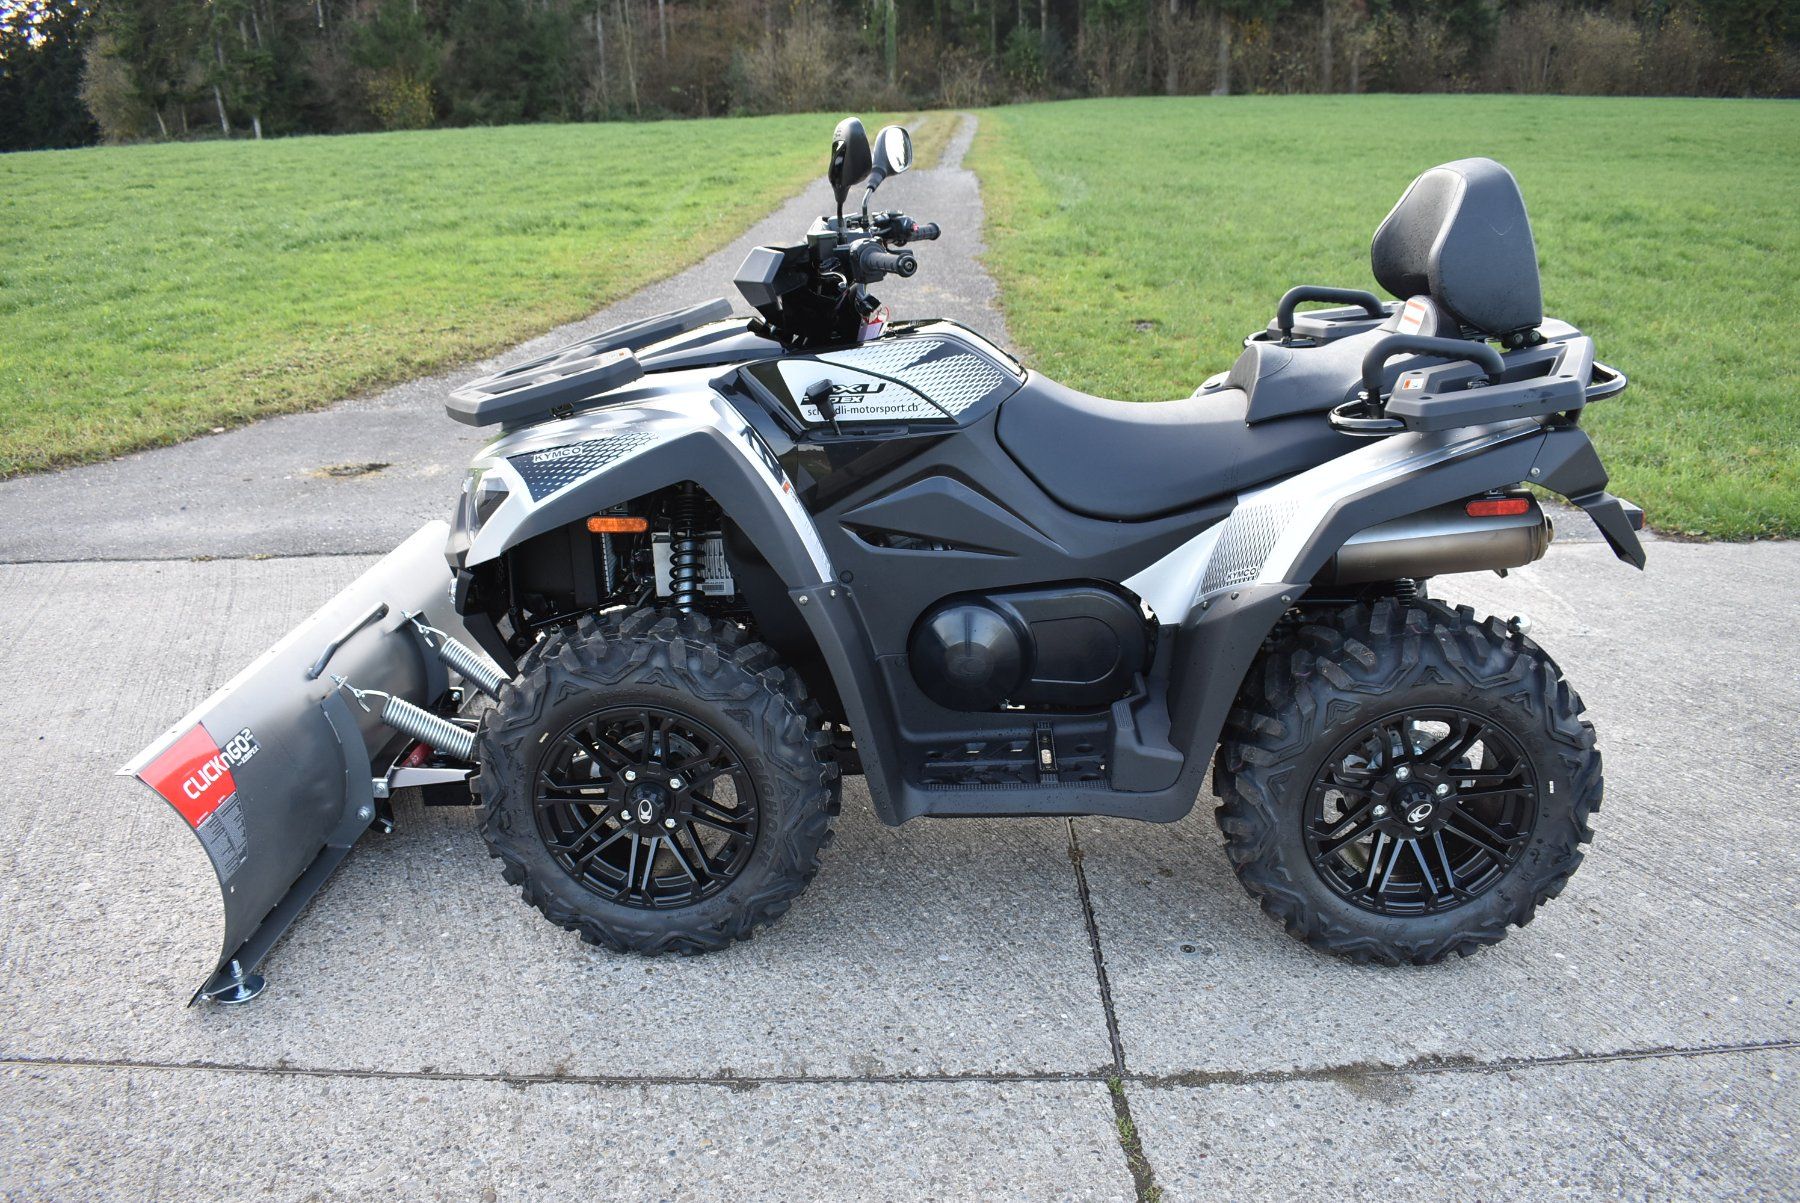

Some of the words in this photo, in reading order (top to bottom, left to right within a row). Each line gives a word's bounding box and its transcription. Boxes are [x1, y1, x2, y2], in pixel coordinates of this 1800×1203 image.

[806, 383, 886, 395] XU
[807, 402, 918, 416] scdli-motorsport.ch
[534, 446, 581, 462] KYMCO
[1227, 567, 1257, 580] KYMCO
